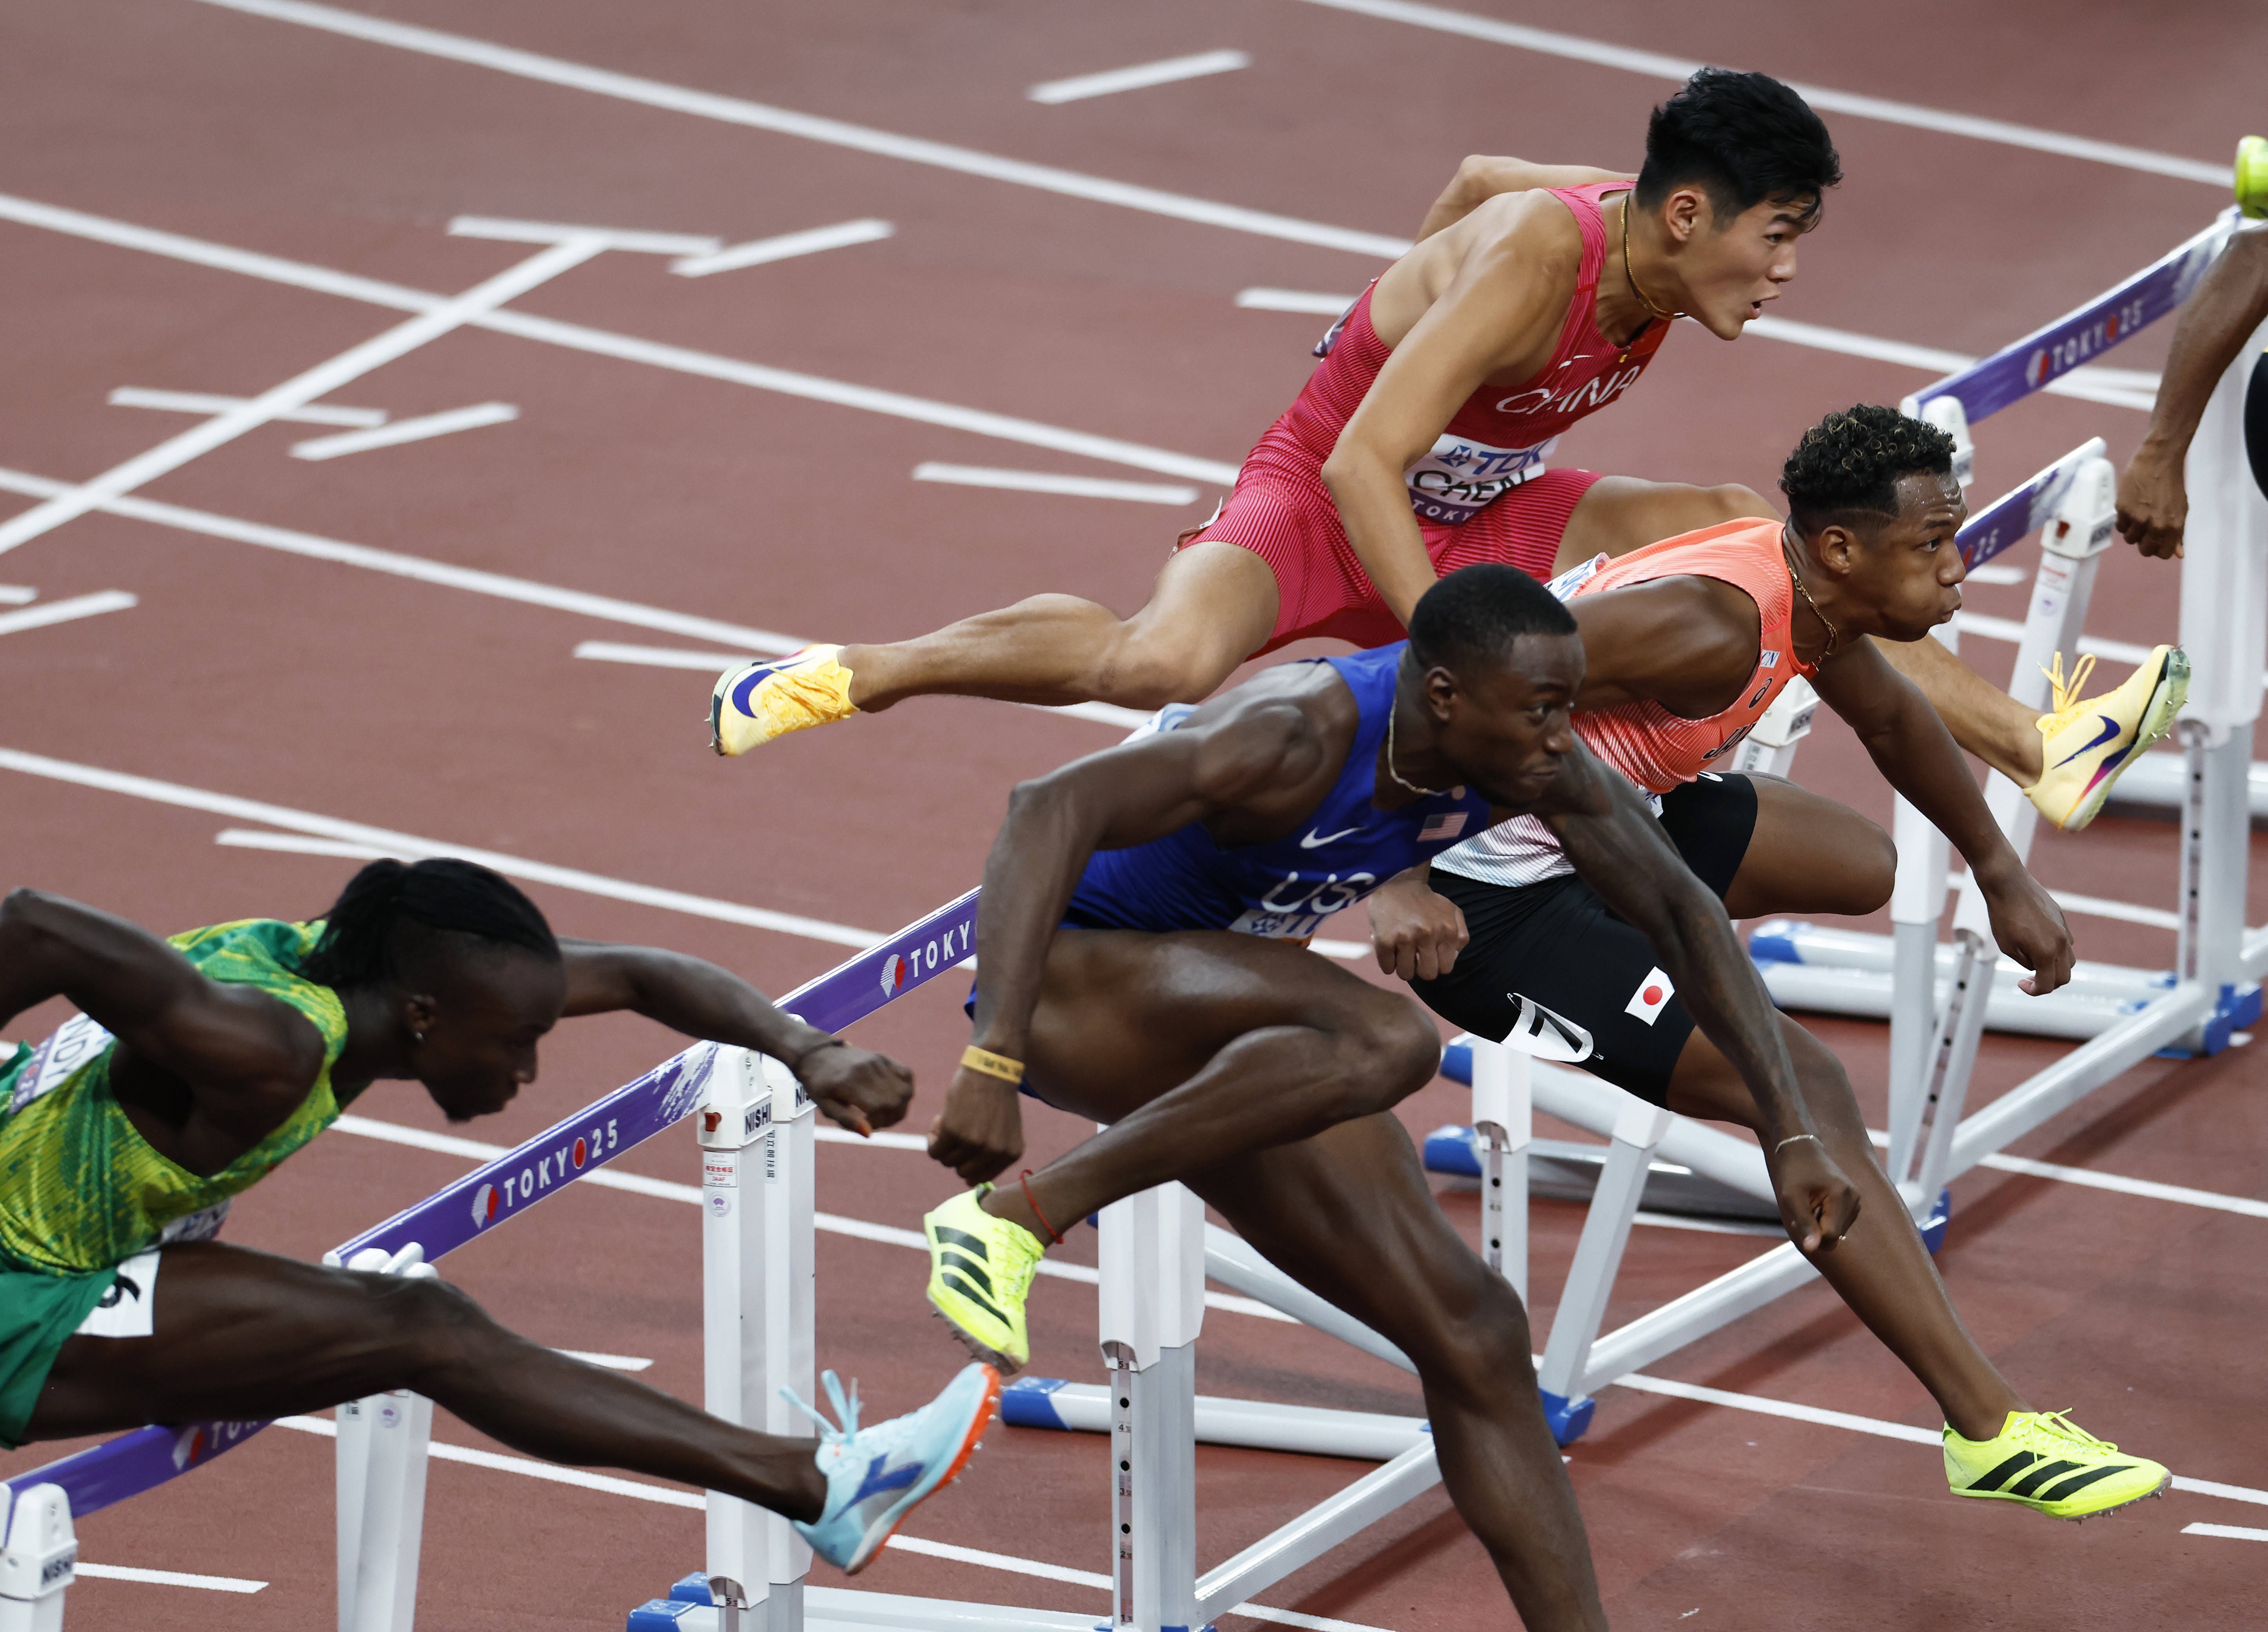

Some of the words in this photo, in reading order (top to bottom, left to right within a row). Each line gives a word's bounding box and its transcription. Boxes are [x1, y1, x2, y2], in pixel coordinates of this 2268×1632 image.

[1496, 365, 1640, 415] CHINA
[1472, 437, 1553, 475] TDK
[1413, 470, 1525, 502] CHEN
[1260, 871, 1376, 914] US
[910, 920, 970, 978] TOKY
[745, 1103, 771, 1135] NISHI
